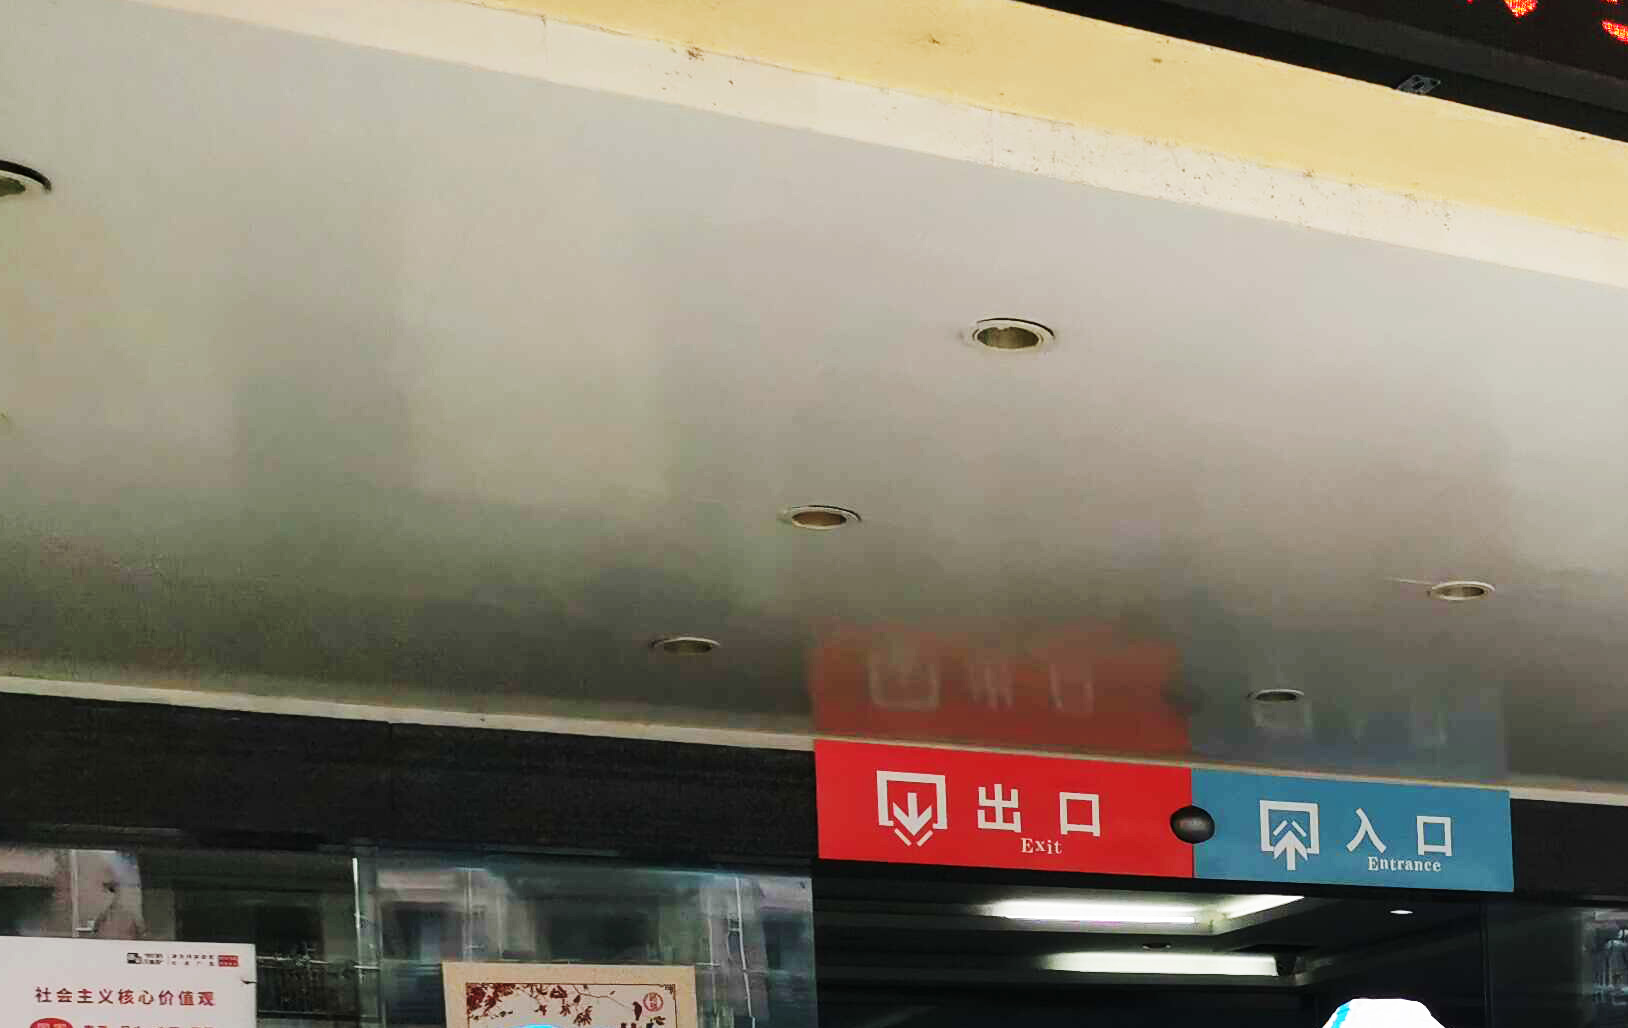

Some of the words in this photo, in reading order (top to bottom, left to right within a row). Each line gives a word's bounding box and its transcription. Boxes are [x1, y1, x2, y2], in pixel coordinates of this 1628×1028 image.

[976, 783, 1101, 837] 出口
[1346, 808, 1453, 857] 入口
[1021, 836, 1063, 855] Exit
[1367, 854, 1442, 874] Entrance
[35, 986, 216, 1007] 社会主义核心价值观
